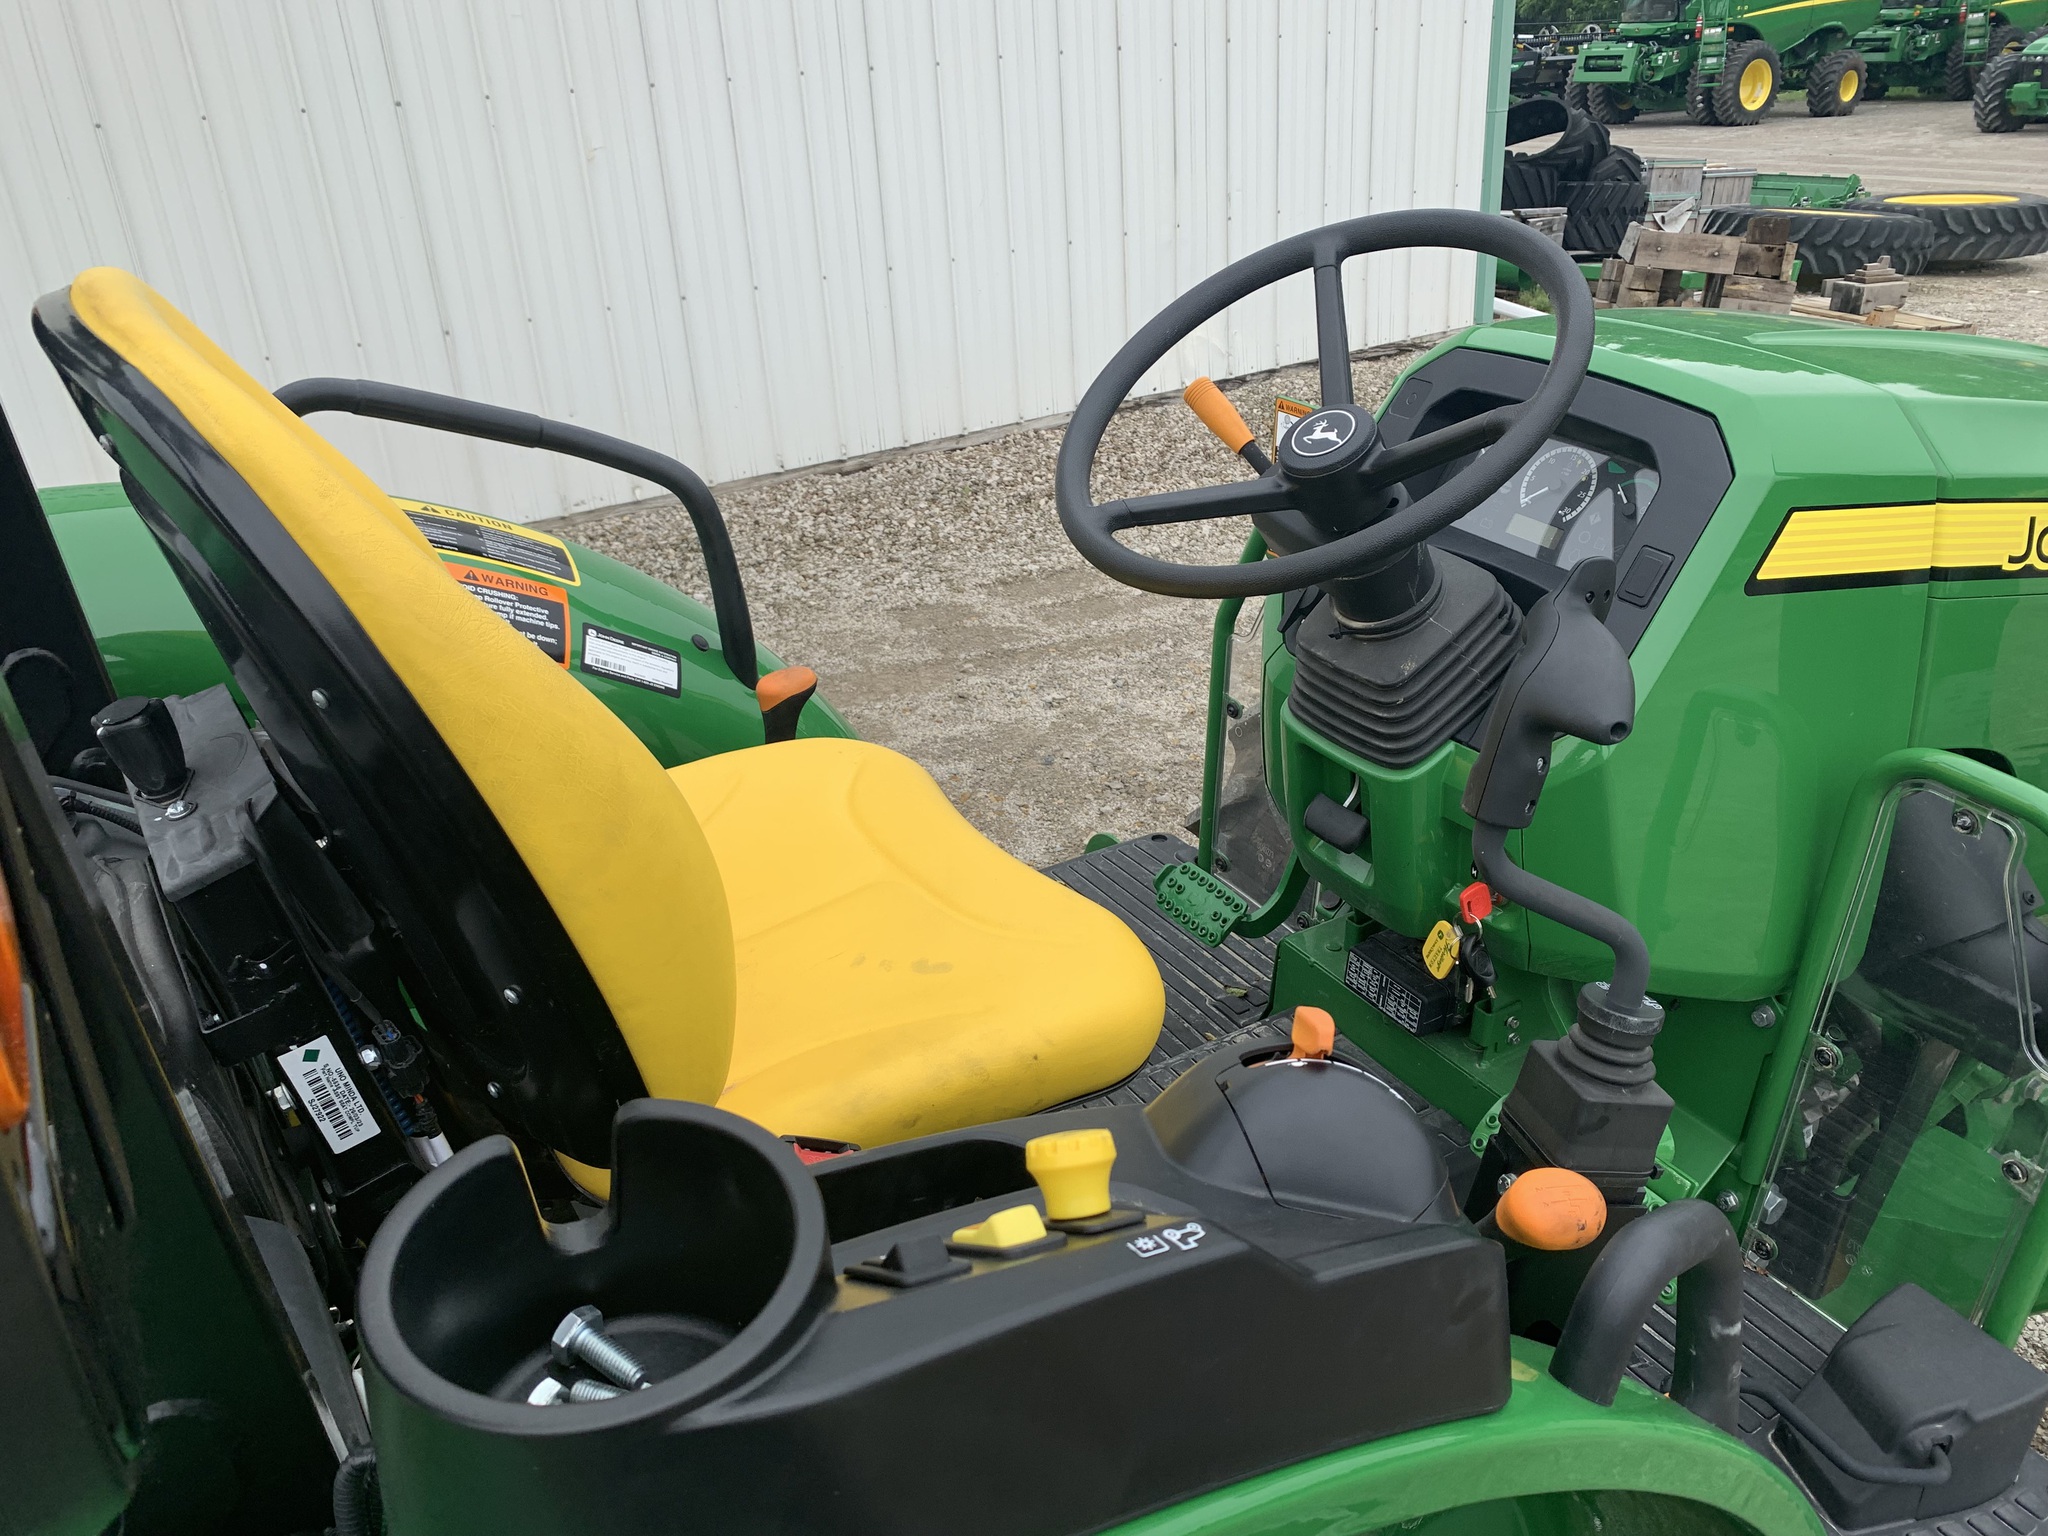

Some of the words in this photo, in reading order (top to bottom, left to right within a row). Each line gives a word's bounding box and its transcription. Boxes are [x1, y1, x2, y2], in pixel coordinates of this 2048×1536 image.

[444, 509, 514, 531] CAUTION
[477, 586, 519, 601] CRUSHING:
[481, 574, 548, 596] WARNING
[484, 596, 514, 607] Rollover
[515, 601, 549, 615] Protective
[499, 605, 515, 614] fully
[516, 609, 549, 621] extended.
[516, 614, 545, 626] machine
[545, 621, 561, 630] tips.
[526, 631, 536, 640] be
[537, 634, 558, 645] down;
[335, 1068, 346, 1081] UNO
[343, 1081, 357, 1101] MINDA
[354, 1101, 364, 1115] LTD.
[308, 1098, 326, 1122] SJ27922
